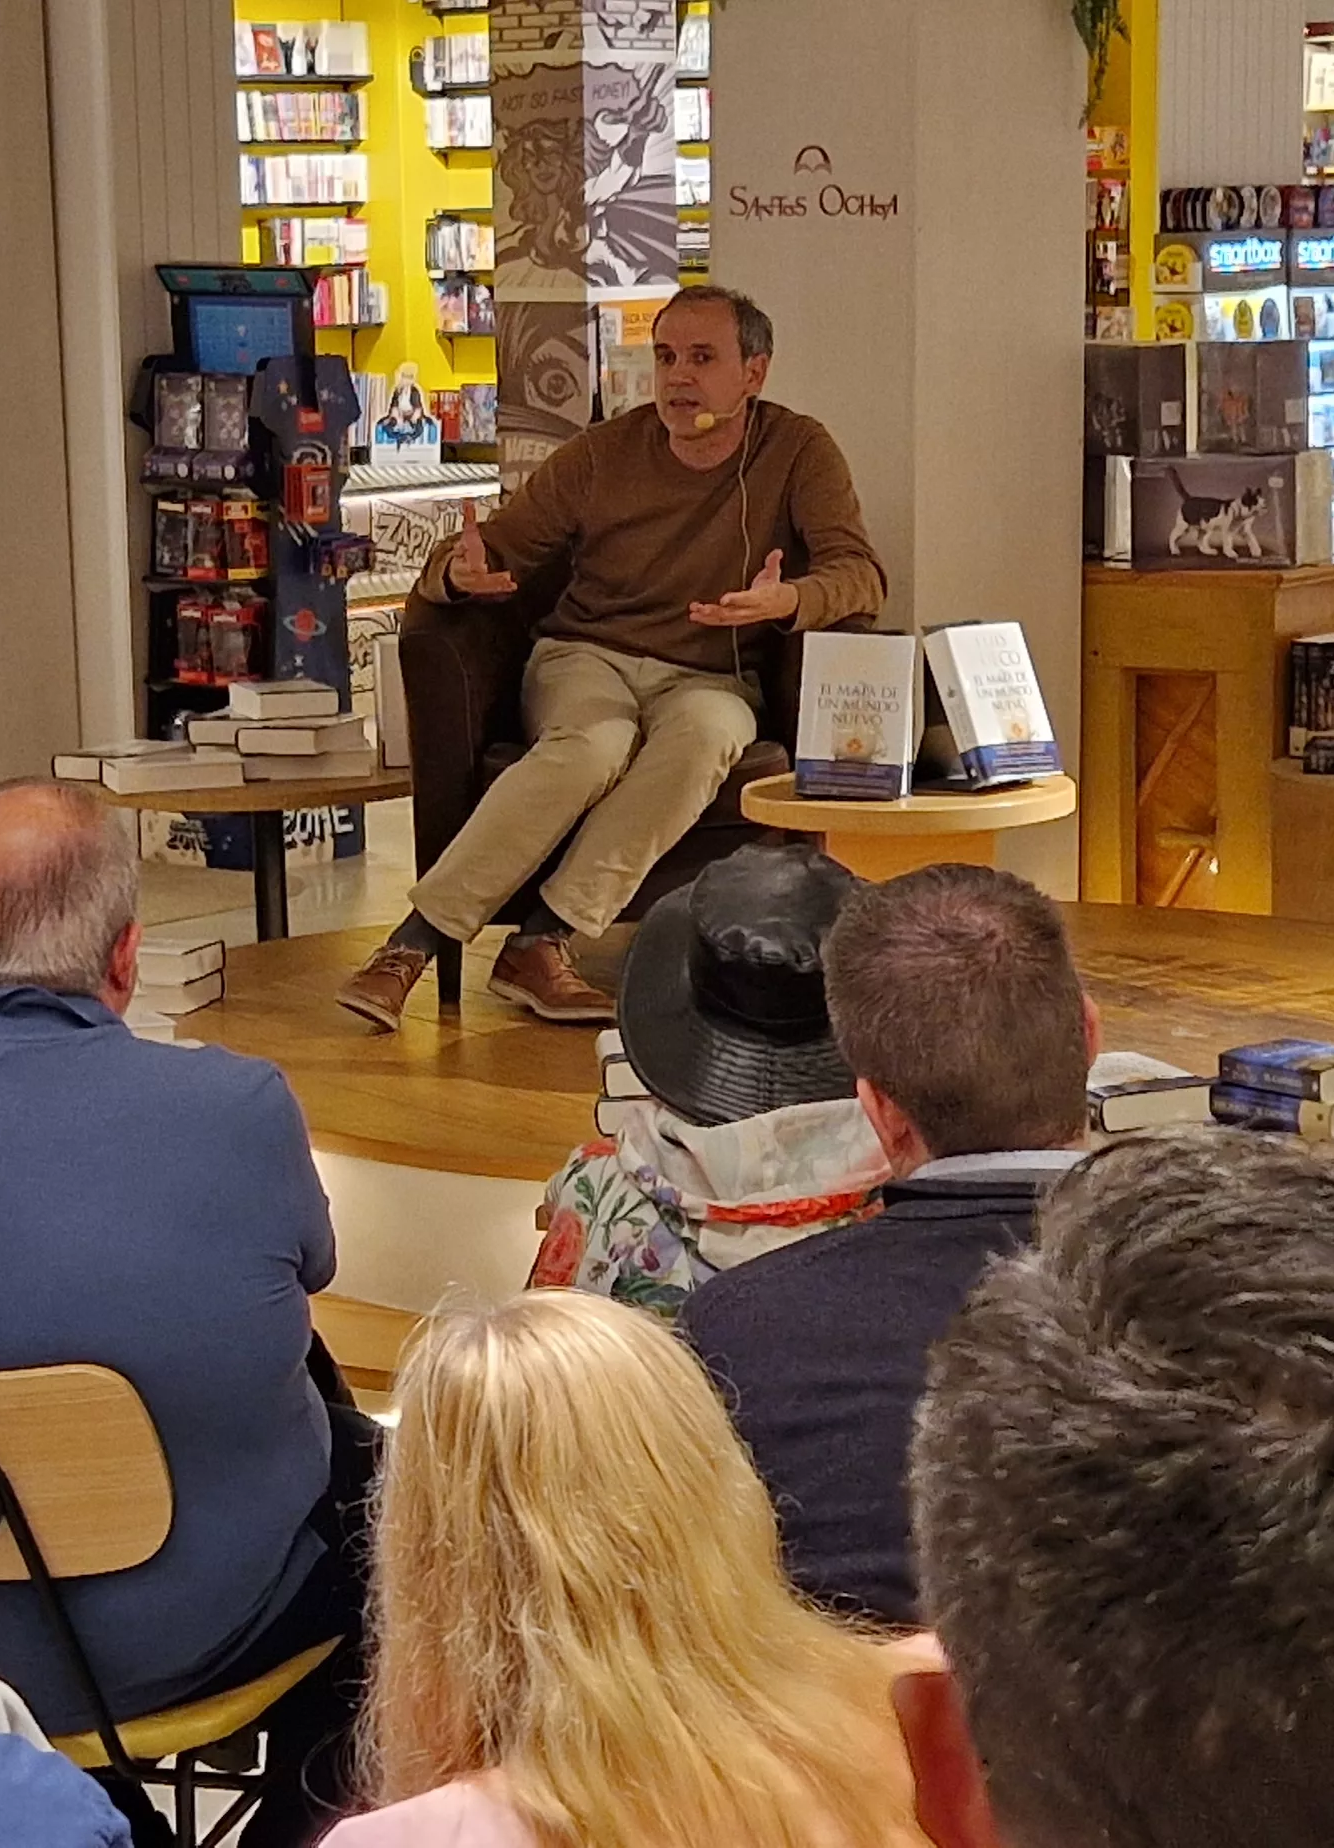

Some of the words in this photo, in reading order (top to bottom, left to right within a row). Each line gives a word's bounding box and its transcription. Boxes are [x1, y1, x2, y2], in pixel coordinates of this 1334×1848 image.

[501, 95, 525, 111] NOT
[729, 185, 807, 221] SANTOS
[819, 184, 898, 220] OCHOA
[1210, 236, 1282, 266] smartbox
